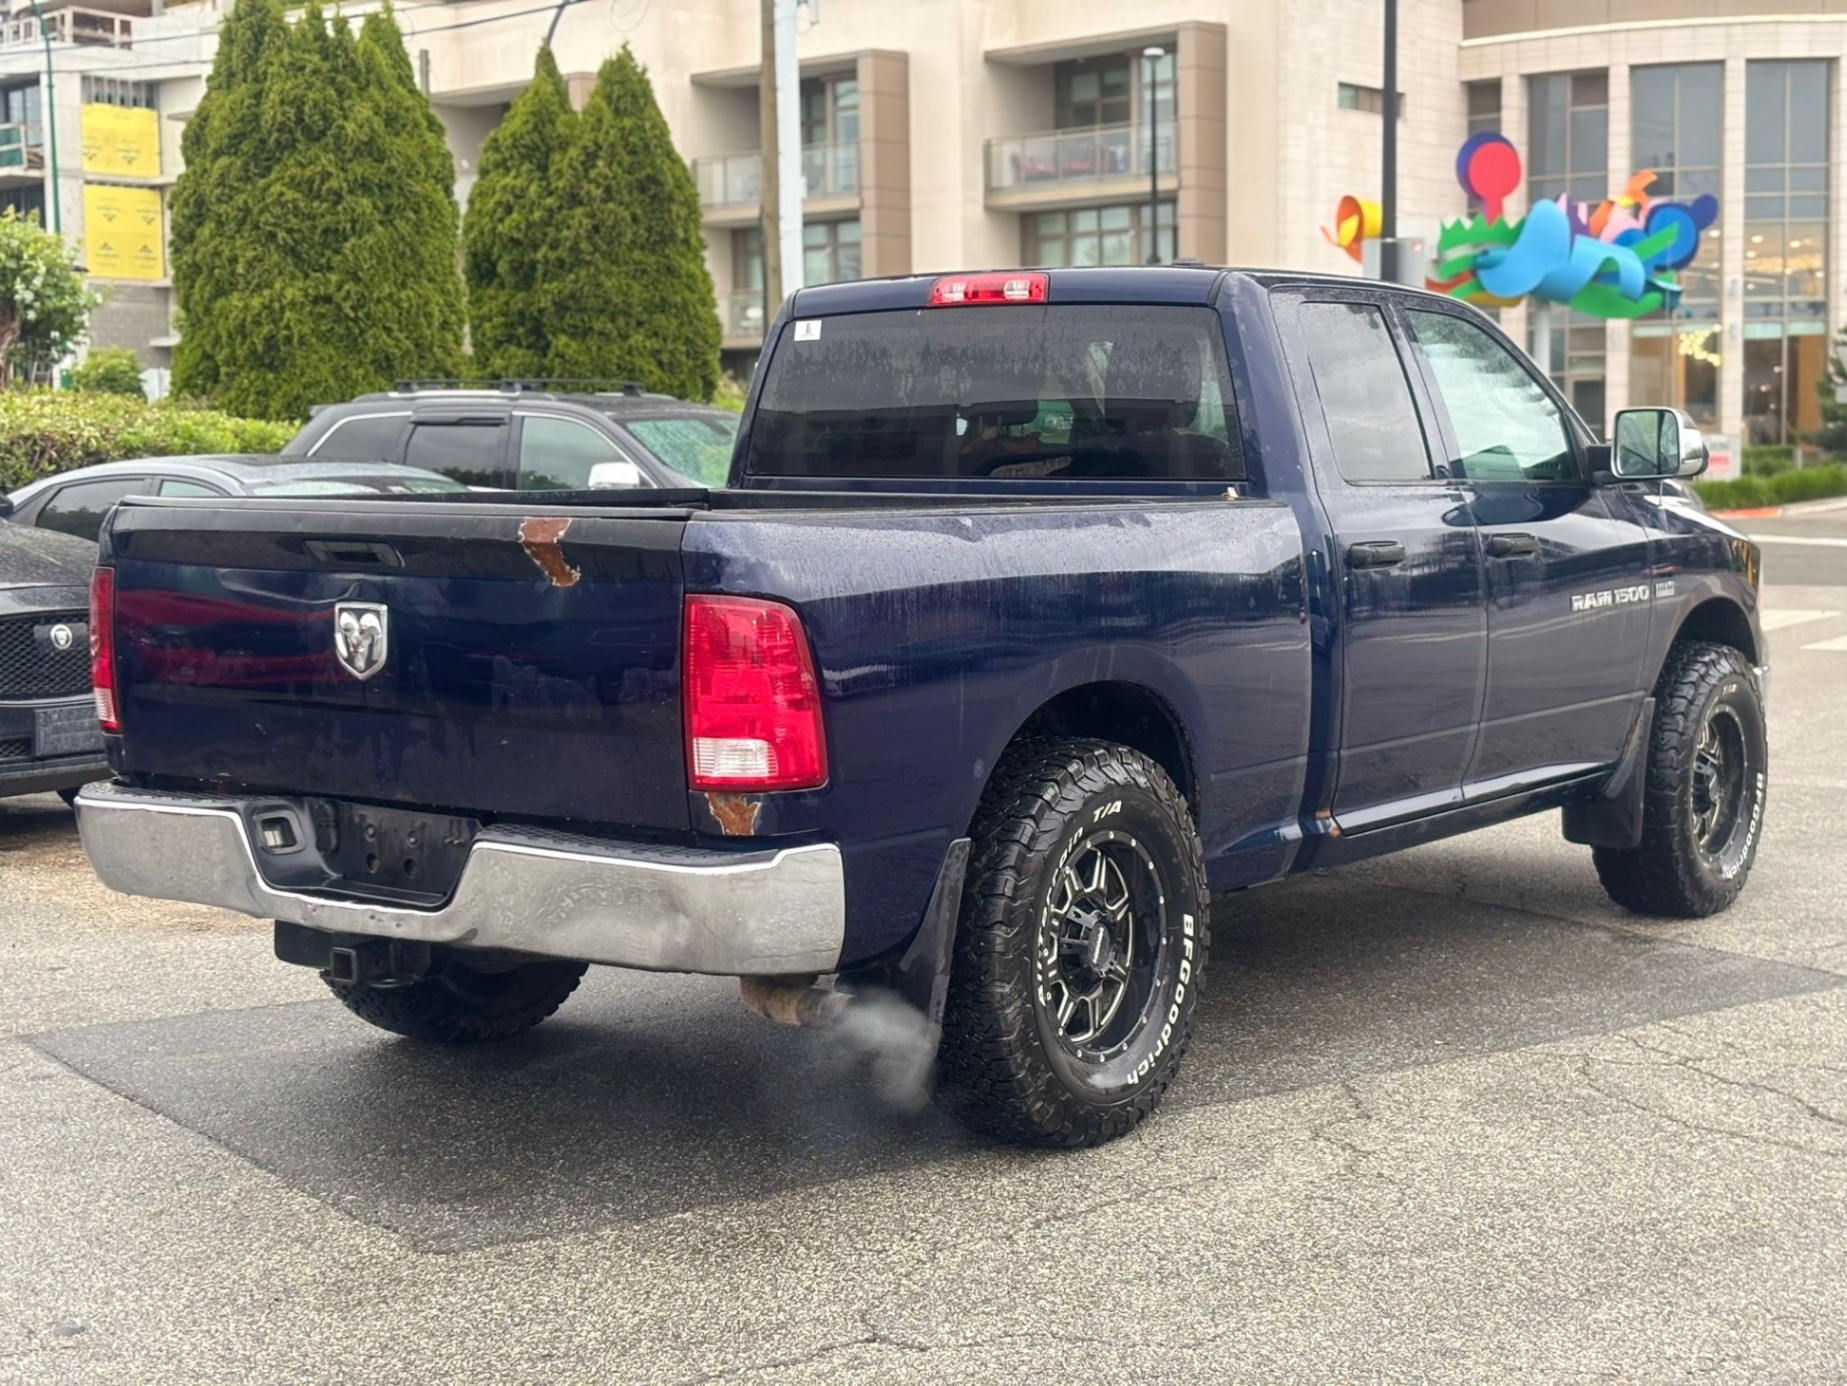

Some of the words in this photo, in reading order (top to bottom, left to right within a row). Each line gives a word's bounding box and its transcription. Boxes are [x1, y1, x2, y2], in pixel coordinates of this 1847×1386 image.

[1571, 590, 1613, 611] RAM
[1613, 585, 1650, 604] 1500
[1093, 800, 1122, 823] T/A
[1126, 913, 1194, 1085] BFGoodrich
